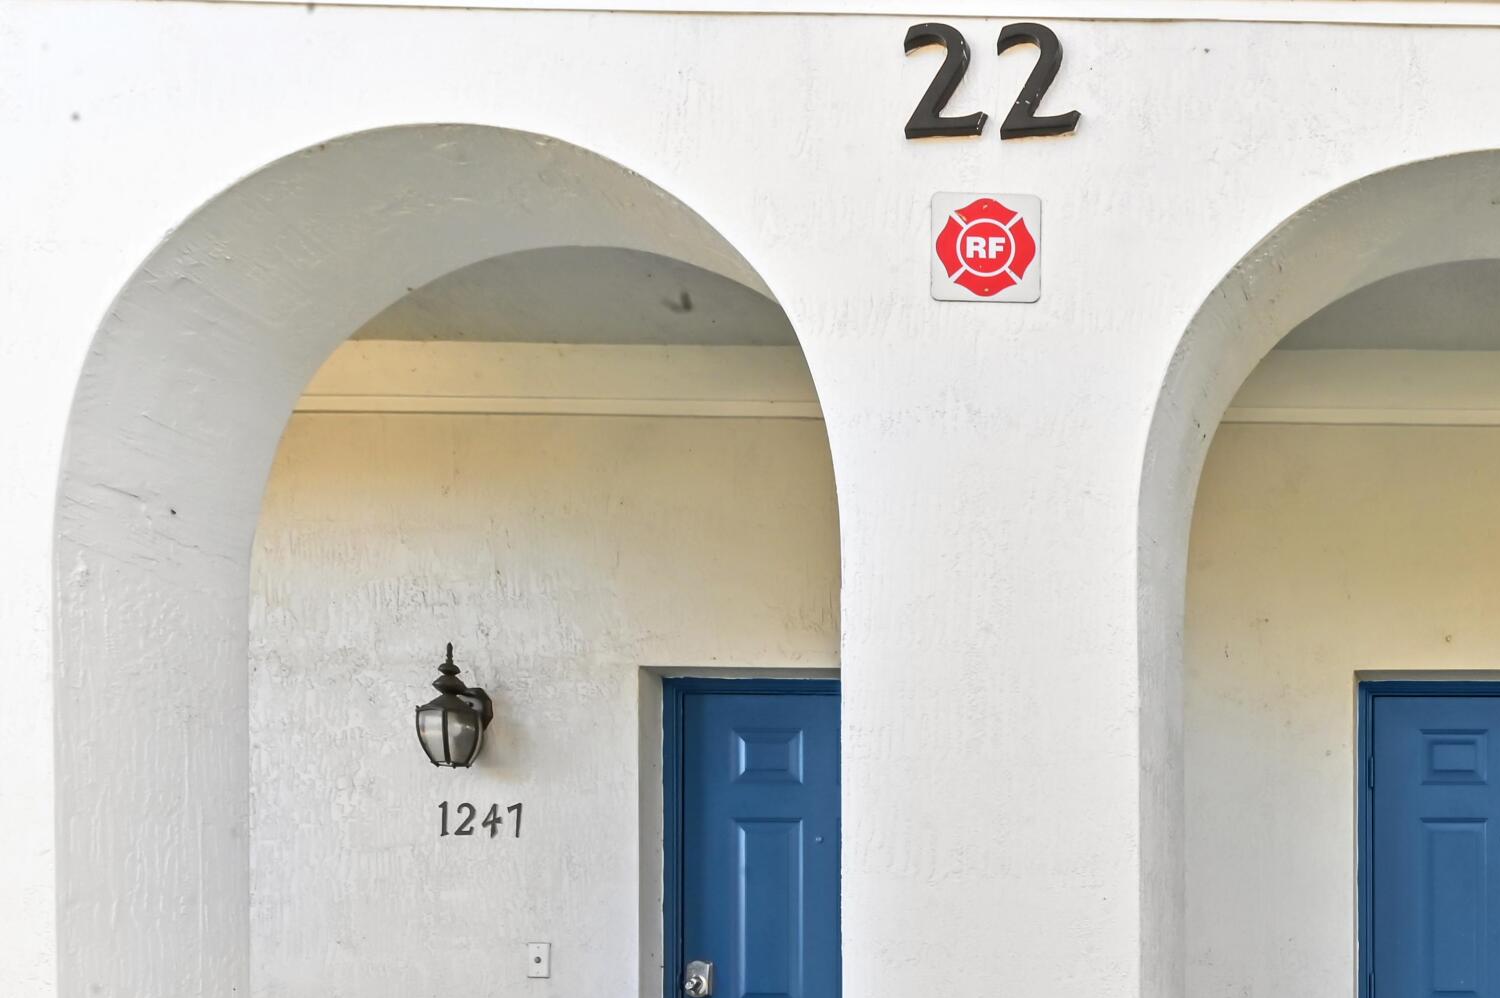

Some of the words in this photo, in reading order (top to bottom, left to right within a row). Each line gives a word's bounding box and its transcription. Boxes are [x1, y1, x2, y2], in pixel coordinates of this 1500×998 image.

[904, 22, 1082, 140] 22
[966, 236, 1006, 259] RF
[438, 801, 523, 838] 1247
